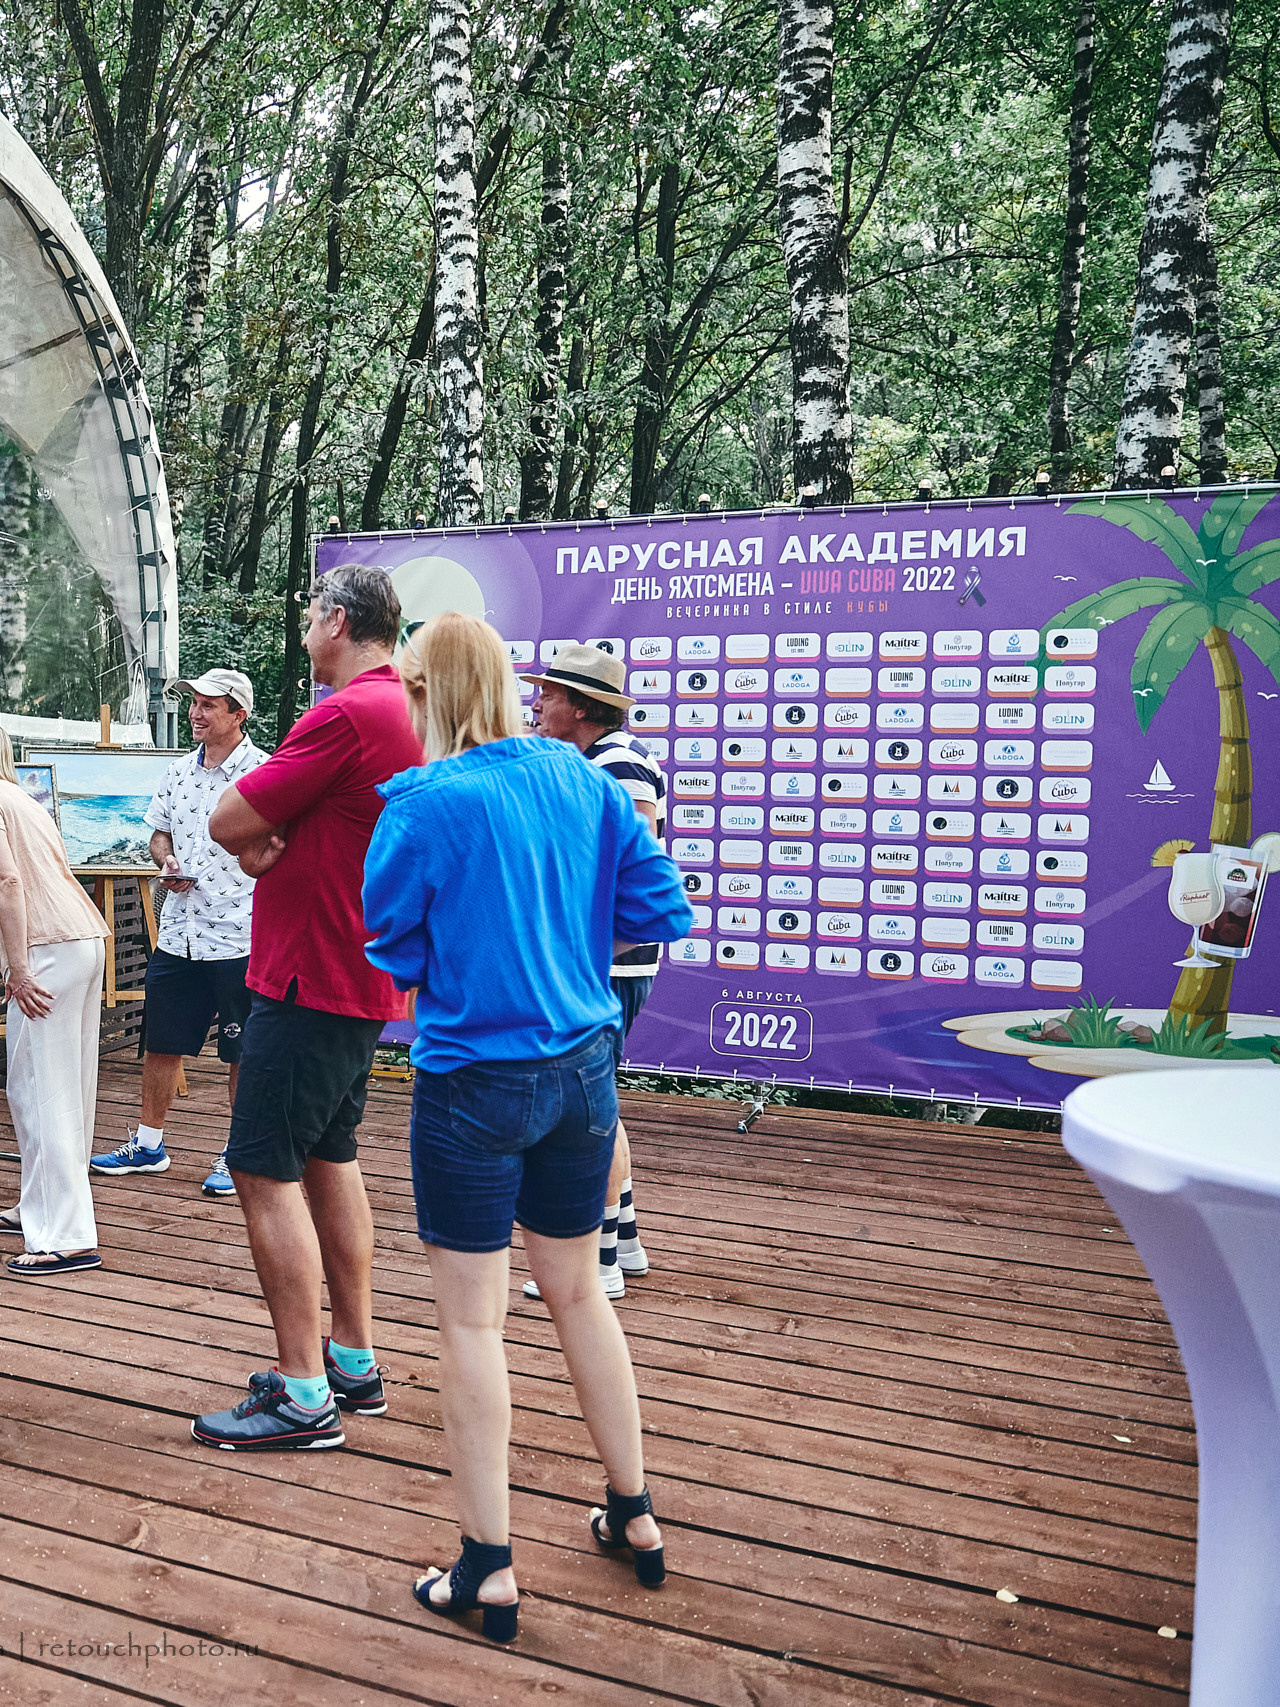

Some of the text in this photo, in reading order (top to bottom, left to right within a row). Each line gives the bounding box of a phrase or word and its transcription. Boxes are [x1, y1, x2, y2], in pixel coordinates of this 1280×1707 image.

[555, 526, 1027, 576] ПАРУСНАЯ АКАДЕМИЯ
[611, 577, 663, 604] ДЕНЬ
[668, 571, 775, 600] ЯХТСМЕНА
[847, 567, 896, 593] CUBA
[902, 565, 956, 593] 2022
[666, 599, 889, 619] ВЕЧЕРИНКА В СТИЛЕ КУБЫ
[787, 638, 809, 647] LUDING
[640, 645, 661, 655] Cuba
[890, 672, 913, 681] LUDING
[735, 677, 756, 687] Cuba
[835, 712, 858, 722] Cuba
[999, 708, 1023, 717] LUDING
[885, 716, 914, 724] LADOGA
[941, 747, 964, 758] Cuba
[1052, 785, 1077, 797] Cuba
[684, 809, 704, 818] LUDING
[780, 846, 802, 855] LUDING
[729, 881, 750, 891] Cuba
[882, 885, 905, 894] LUDING
[828, 920, 850, 932] Cuba
[989, 926, 1013, 935] LUDING
[877, 928, 906, 936] LADOGA
[932, 961, 956, 974] Cuba
[721, 988, 803, 1003] 6 АВГУСТА
[724, 1011, 798, 1050] 2022
